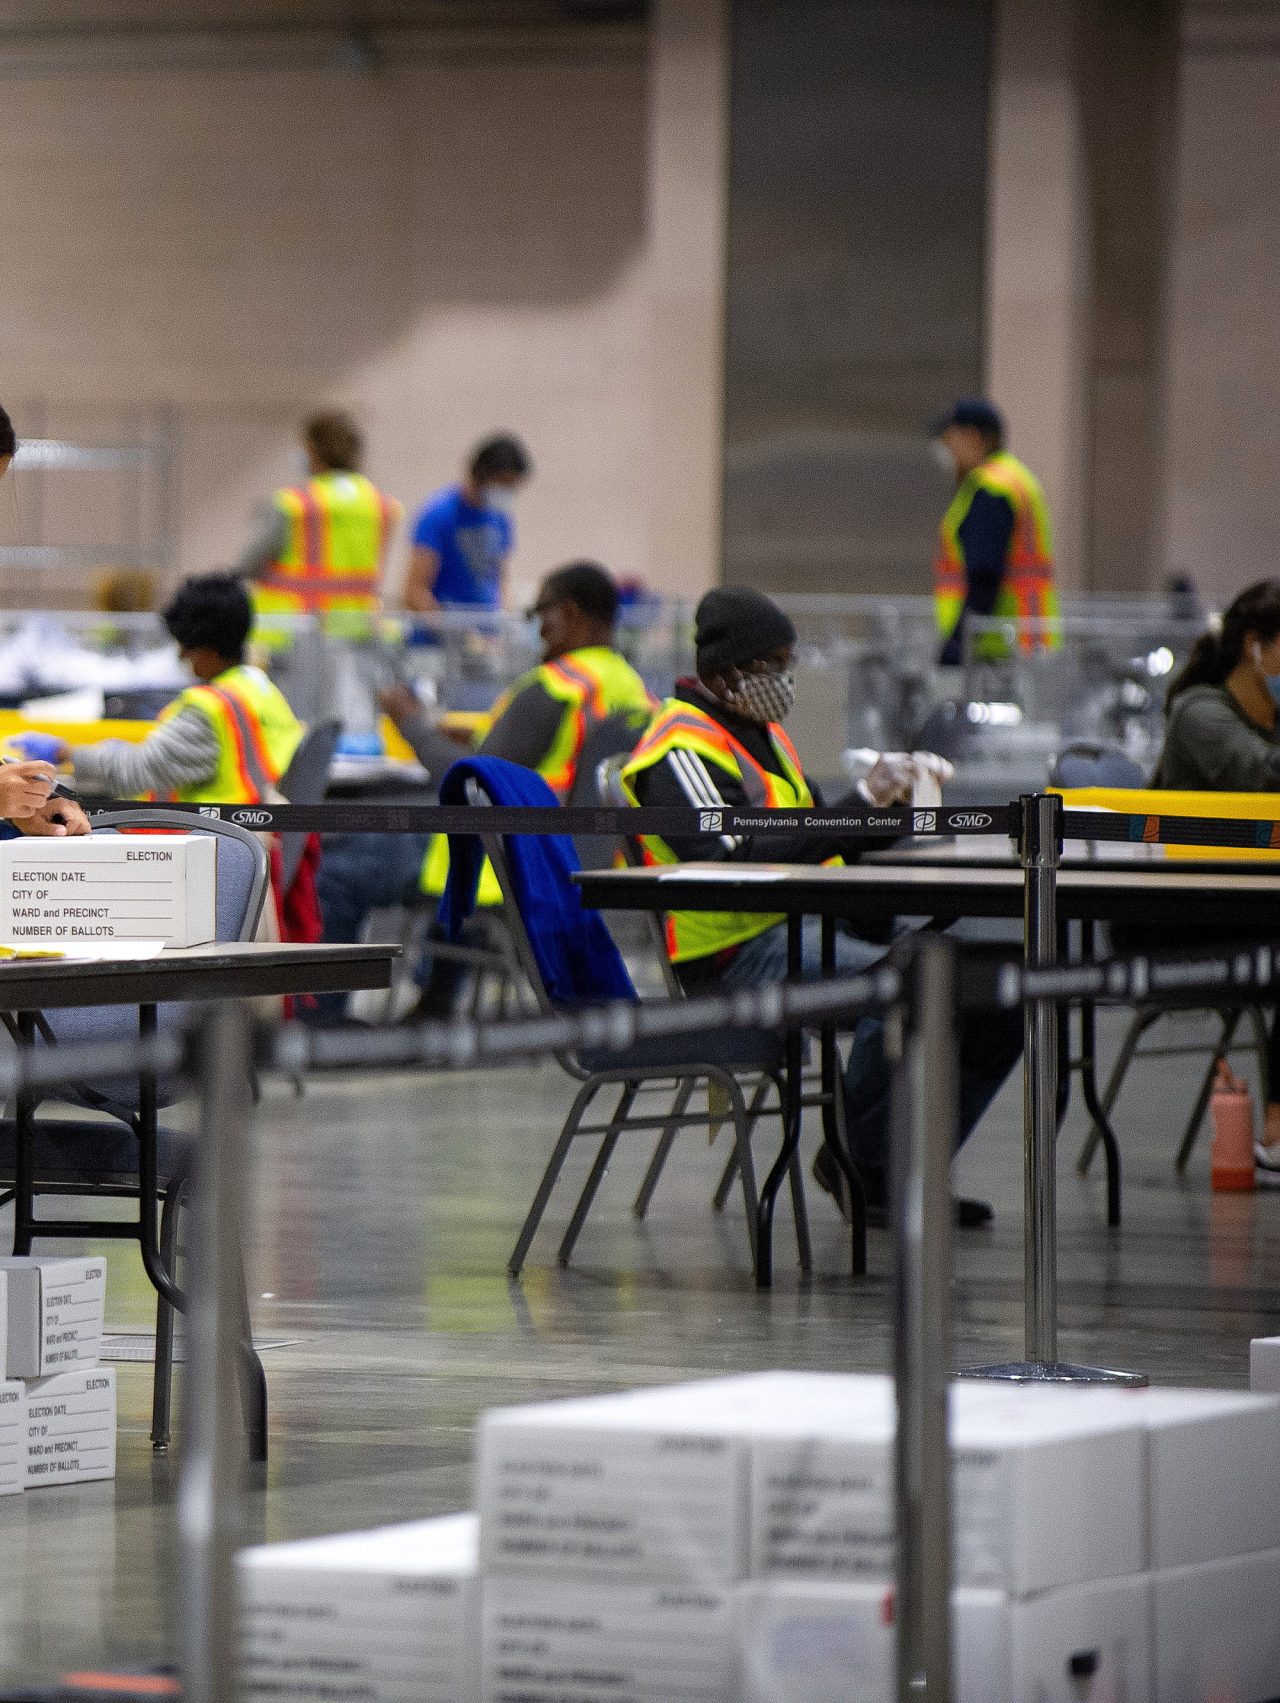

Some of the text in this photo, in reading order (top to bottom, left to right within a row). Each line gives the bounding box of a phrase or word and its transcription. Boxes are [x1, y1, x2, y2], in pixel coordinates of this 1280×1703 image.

[237, 811, 266, 824] SMG
[733, 816, 902, 828] Pennsylvania Convention Center
[953, 814, 987, 827] SMG
[126, 851, 172, 861] ELECTION
[12, 872, 86, 882] ELECTION DATE
[12, 890, 49, 899] CITY OF
[12, 908, 110, 918] WARD and PRECINCT
[12, 926, 114, 936] NUMBER OF BALLOTS
[86, 1378, 110, 1391] ELECTION
[28, 1404, 67, 1418] ELECTION DATE
[28, 1425, 48, 1437] CITY OF
[28, 1441, 78, 1456] WARD and PRECINCT
[28, 1460, 80, 1475] NUMBER OF BALLOTS
